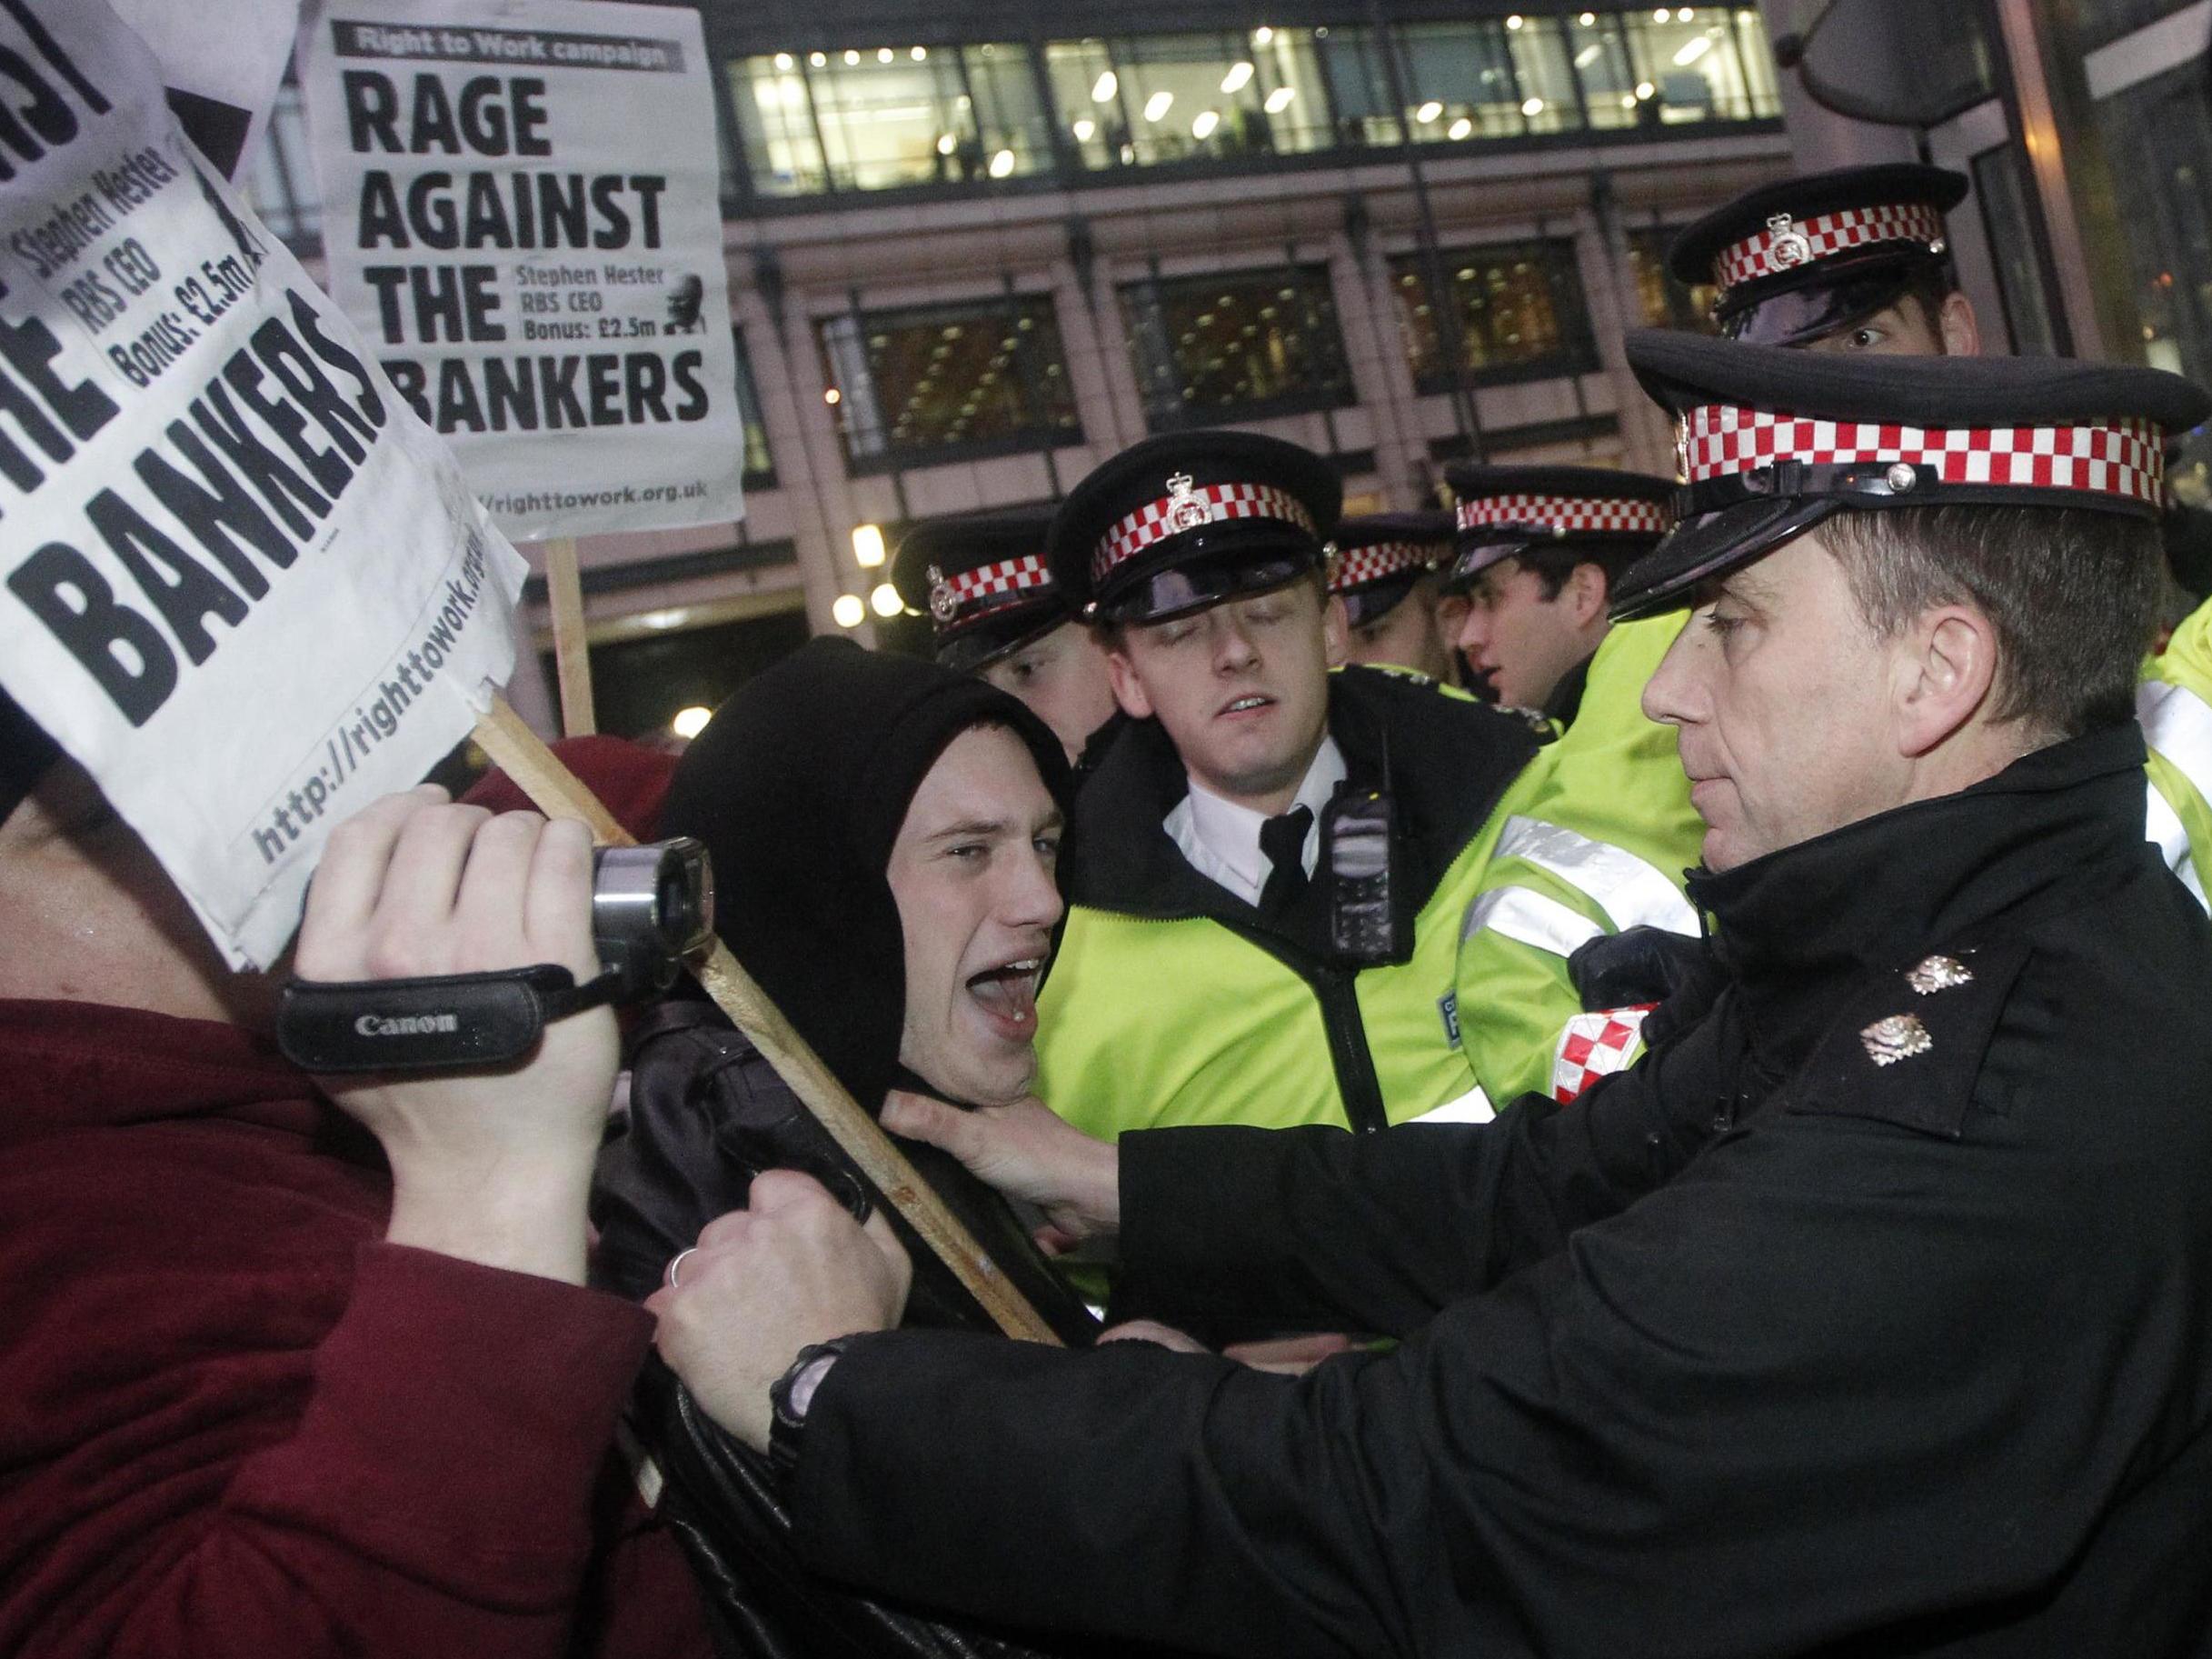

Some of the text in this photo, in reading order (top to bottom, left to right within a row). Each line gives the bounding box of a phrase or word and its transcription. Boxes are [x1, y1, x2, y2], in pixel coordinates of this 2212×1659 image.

[355, 25, 669, 68] Right to Work campaign
[342, 69, 552, 156] RAGE
[11, 146, 179, 278] Stephen Hester
[358, 170, 666, 250] AGAINST
[60, 237, 162, 335] RBS CEO
[364, 265, 506, 344] THE
[516, 265, 664, 286] Stephen Hester
[520, 290, 603, 314] RBS CEO
[107, 255, 255, 388] Bonus: £2.5m
[523, 316, 656, 341] Bonus: £2.5m
[6, 288, 387, 728] BANKERS
[354, 1014, 458, 1037] Canon
